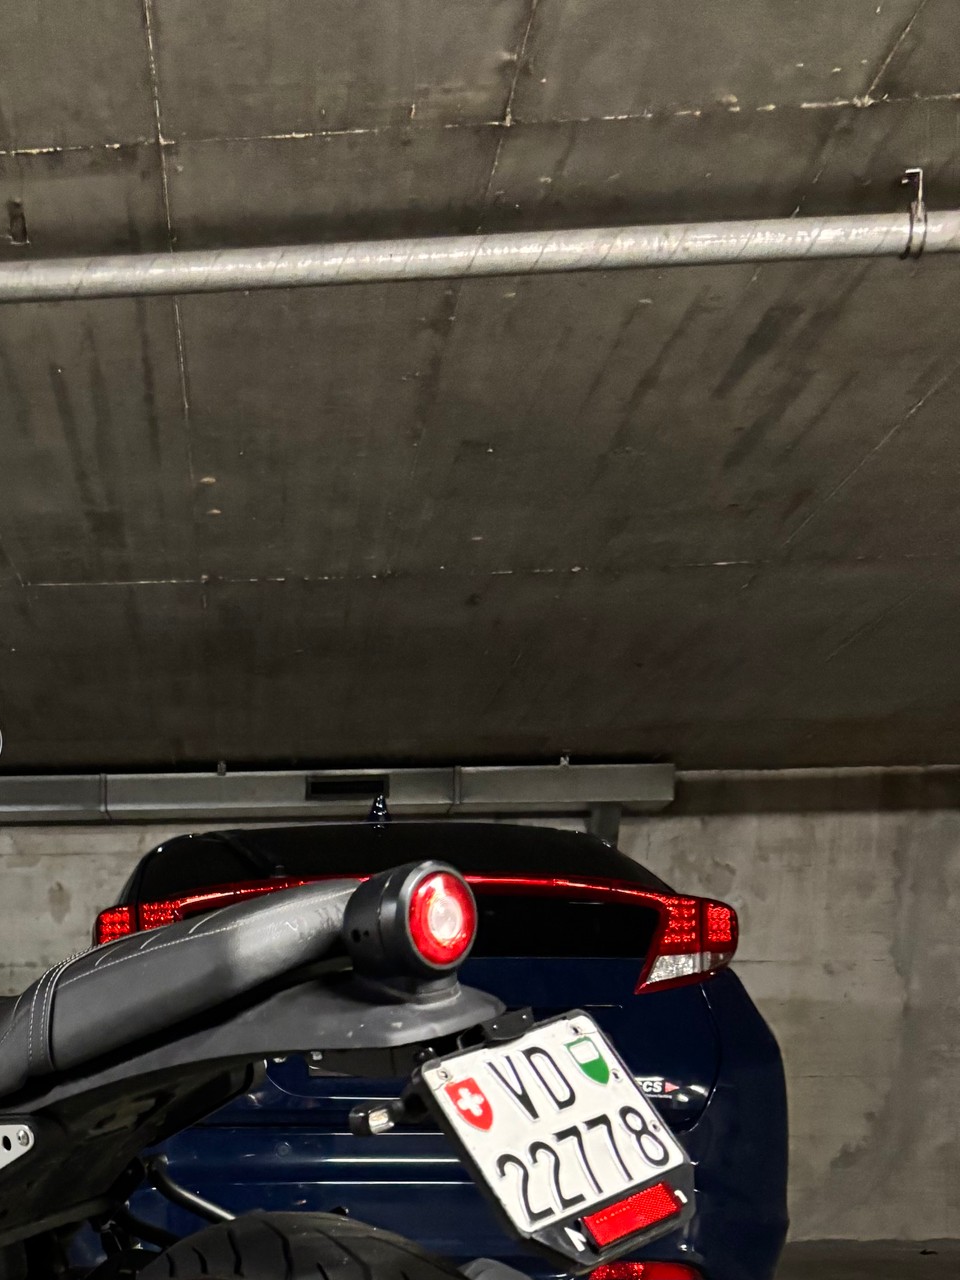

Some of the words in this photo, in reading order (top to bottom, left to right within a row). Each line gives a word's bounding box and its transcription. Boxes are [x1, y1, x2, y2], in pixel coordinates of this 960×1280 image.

[487, 1047, 576, 1120] VD
[638, 1081, 663, 1093] CS
[496, 1106, 669, 1221] 22778
